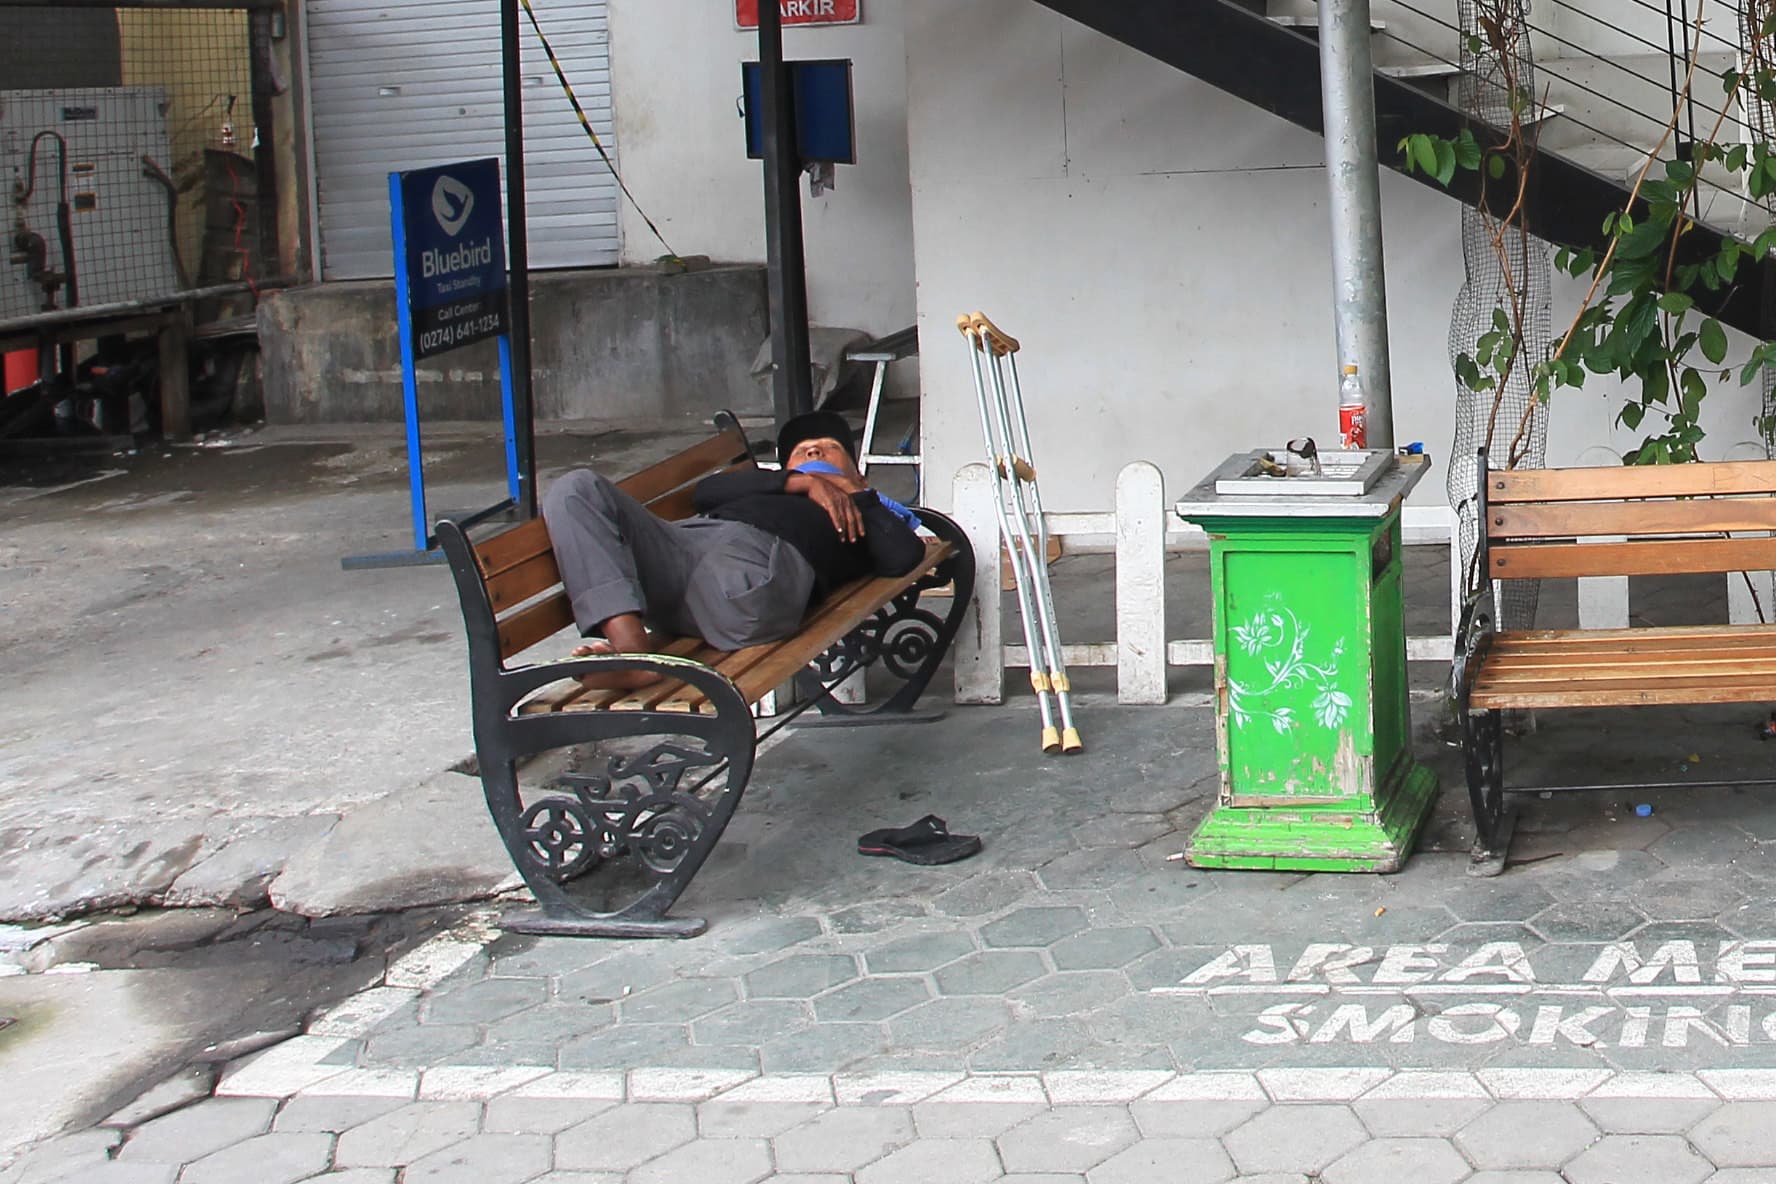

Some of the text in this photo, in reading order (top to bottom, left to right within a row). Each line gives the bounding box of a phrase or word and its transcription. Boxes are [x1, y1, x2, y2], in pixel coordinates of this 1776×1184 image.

[422, 237, 491, 278] Bluebird
[438, 303, 481, 320] Call Center
[420, 314, 499, 353] (0274) 641-1234
[1179, 941, 1536, 984] AREA
